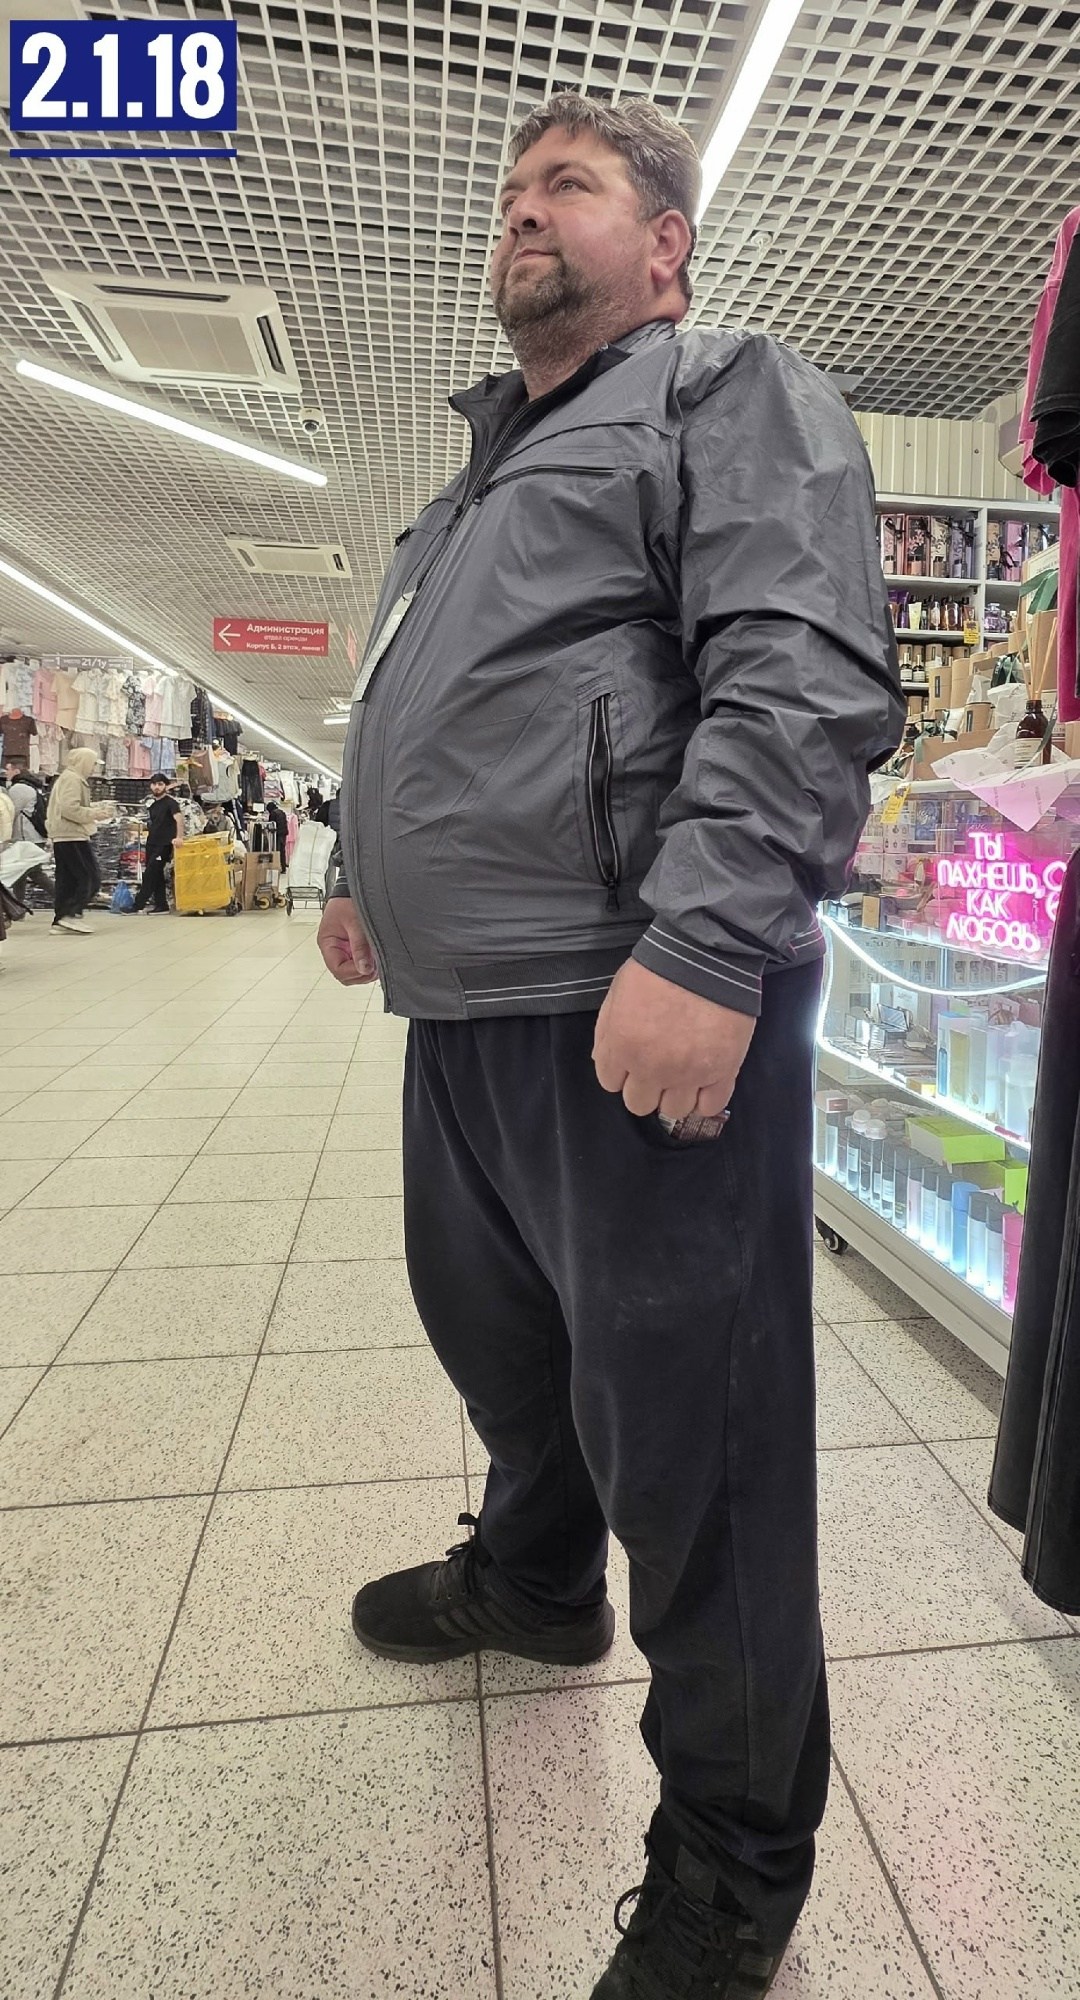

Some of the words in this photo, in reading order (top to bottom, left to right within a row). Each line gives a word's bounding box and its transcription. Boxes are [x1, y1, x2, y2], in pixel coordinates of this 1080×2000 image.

[247, 624, 324, 635] Администрация
[246, 642, 269, 650] Корпус
[968, 832, 1005, 860] ТЫ
[937, 859, 1046, 899] ПАХНЕШЬ,
[966, 888, 1011, 920] КАК
[946, 912, 1041, 953] ЛЮБОВЬ
